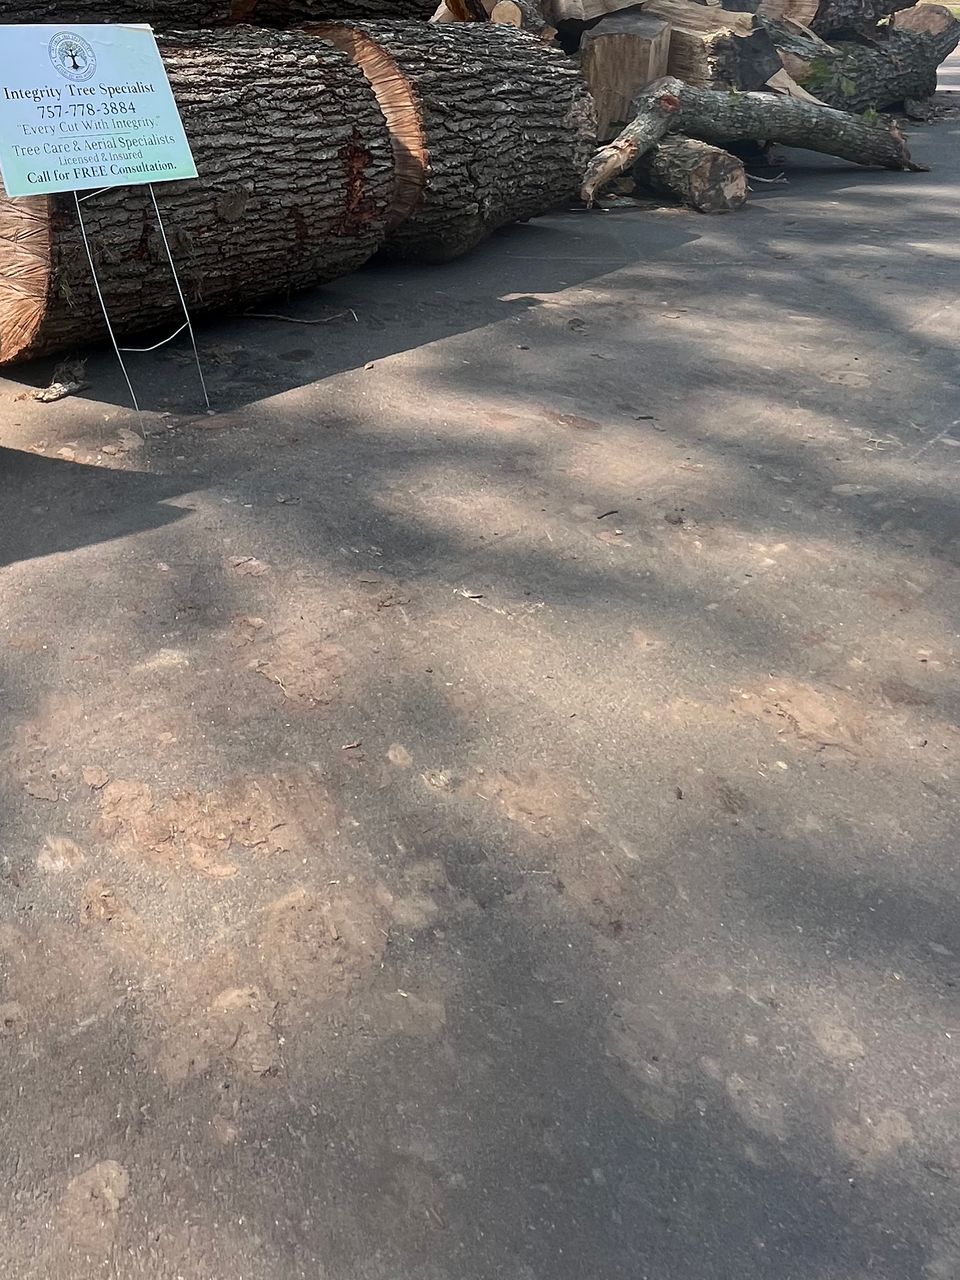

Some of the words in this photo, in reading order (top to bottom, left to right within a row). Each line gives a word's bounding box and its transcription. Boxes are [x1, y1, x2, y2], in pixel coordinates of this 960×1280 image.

[4, 85, 62, 102] Integrity
[65, 84, 95, 97] Tree
[99, 81, 155, 99] Specialist
[37, 101, 136, 119] 757-778-3884
[59, 121, 80, 133] Cut
[81, 119, 109, 131] With
[12, 144, 41, 157] Tree
[44, 142, 71, 155] Care
[73, 141, 81, 152] &
[84, 137, 117, 151] Aerial
[118, 133, 176, 151] Specialists
[58, 153, 99, 166] Licensed
[101, 152, 108, 162] &
[109, 150, 143, 161] Insured
[27, 171, 50, 184] Call
[53, 169, 70, 182] for
[73, 165, 108, 179] FREE
[110, 161, 177, 176] Consultation.
